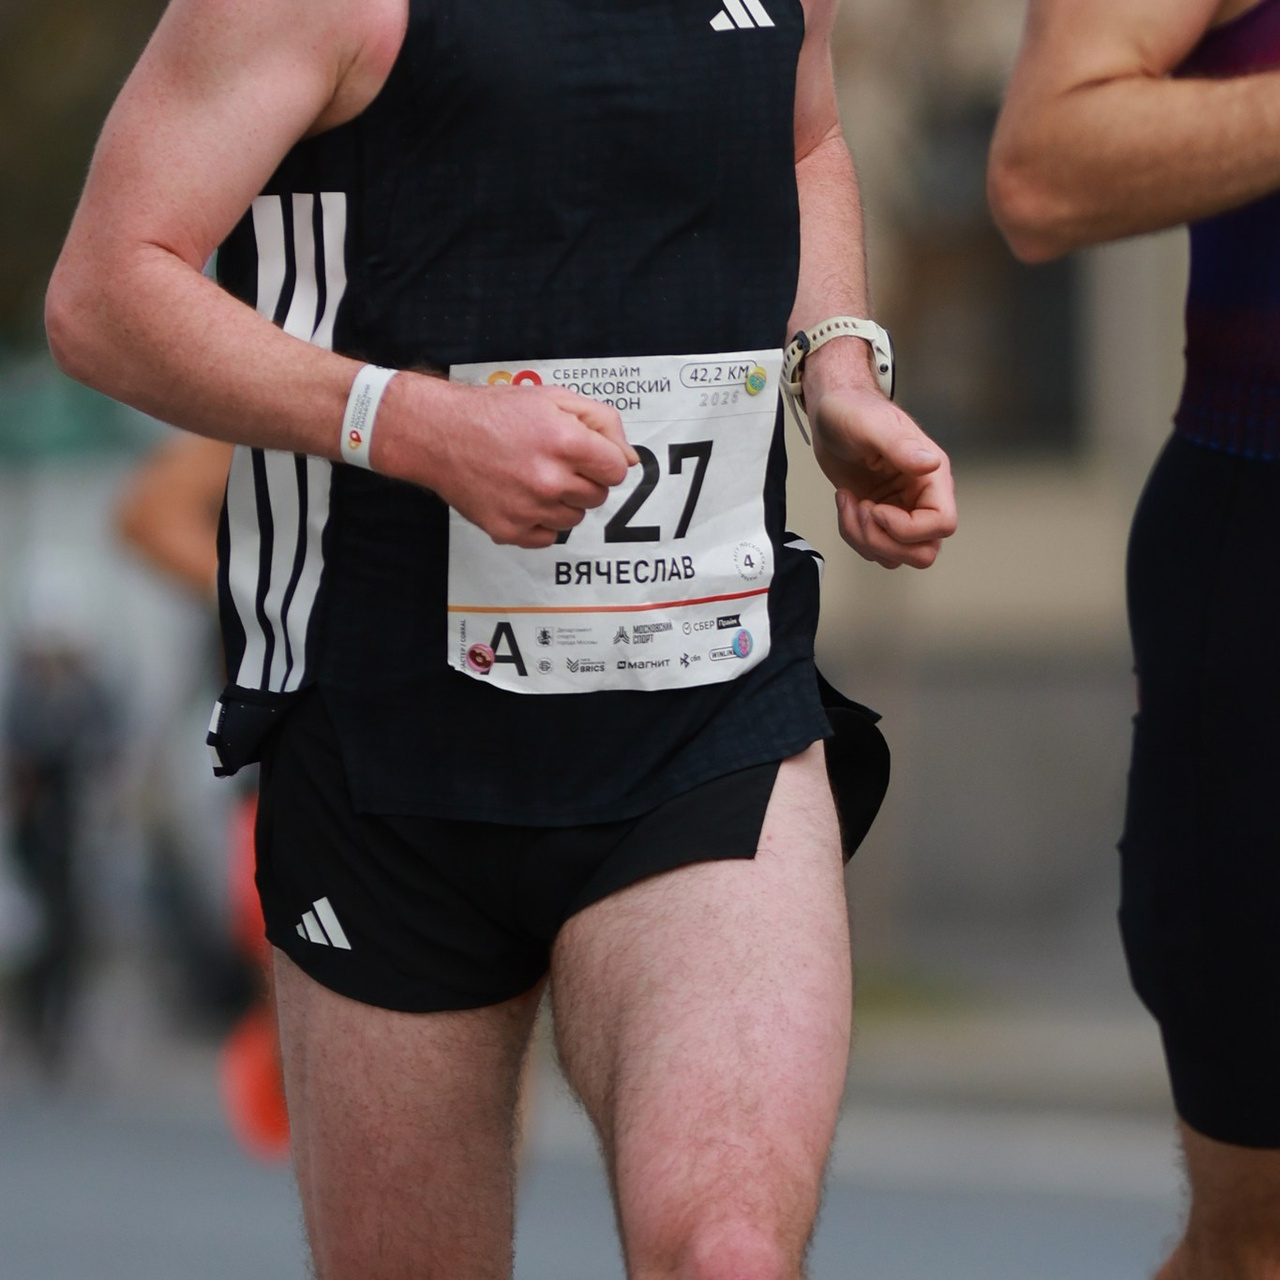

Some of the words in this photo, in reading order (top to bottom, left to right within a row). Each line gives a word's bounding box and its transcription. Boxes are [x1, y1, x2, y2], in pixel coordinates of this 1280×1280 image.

[552, 365, 641, 380] СБЕРПРАЙМ
[689, 367, 723, 383] 42,2
[728, 365, 750, 380] КМ
[553, 376, 672, 396] ОСКОВСКИЙ
[553, 440, 714, 545] 27
[743, 554, 755, 568] 4
[555, 555, 696, 585] ВЯЧЕСЛАВ
[693, 621, 716, 632] СБЕР
[632, 633, 654, 645] СПОРТ
[711, 649, 737, 659] WINLIN
[580, 665, 605, 673] BRICS
